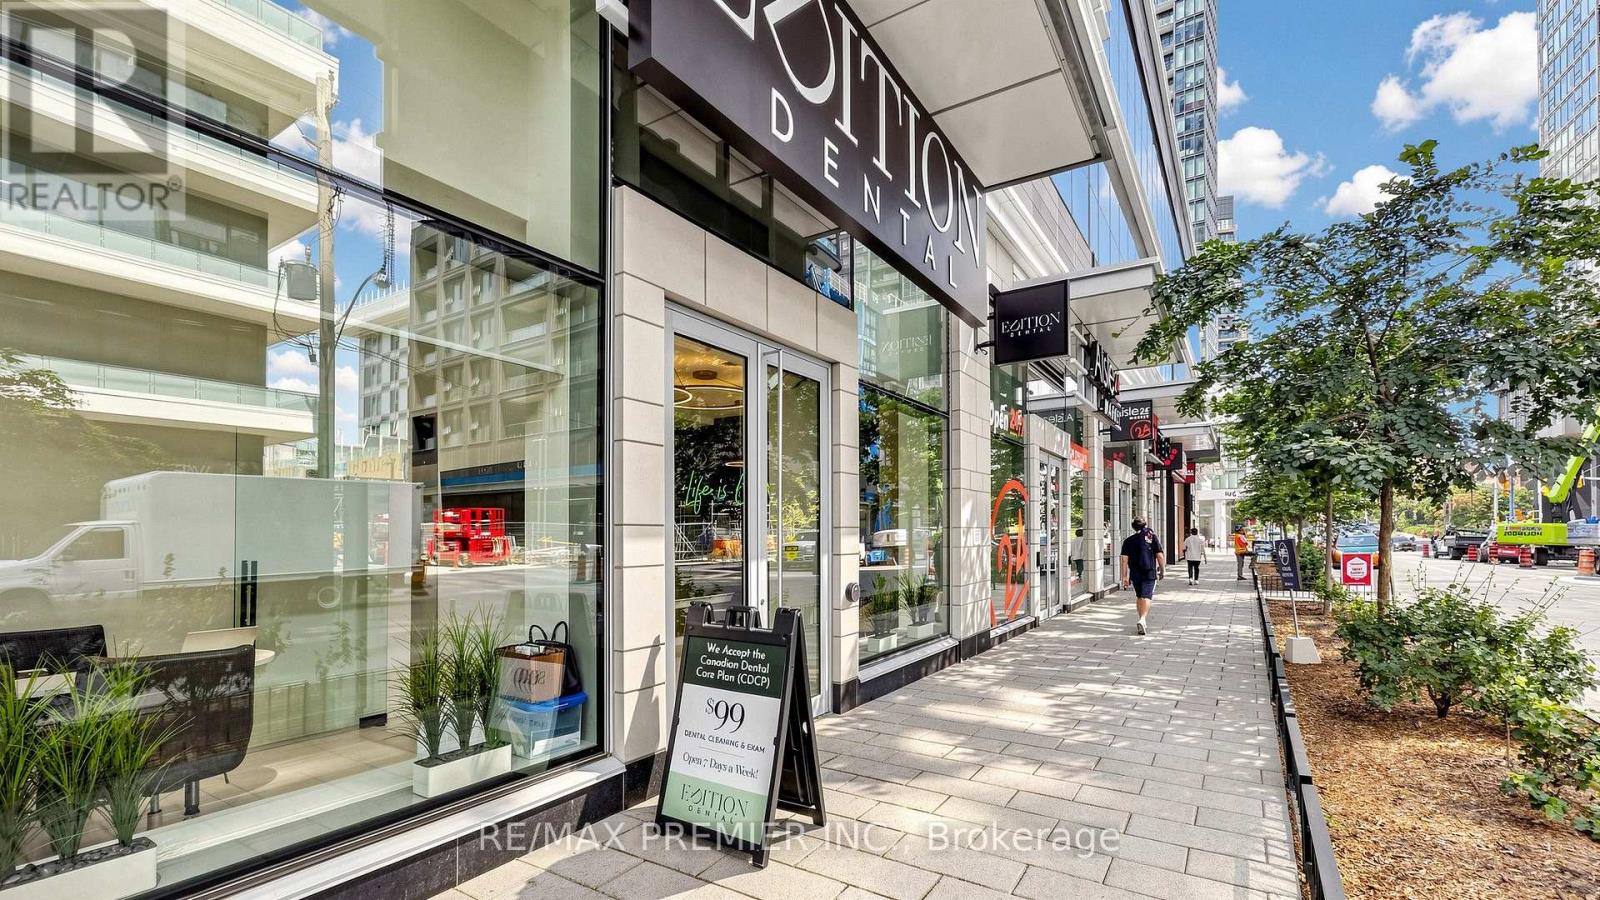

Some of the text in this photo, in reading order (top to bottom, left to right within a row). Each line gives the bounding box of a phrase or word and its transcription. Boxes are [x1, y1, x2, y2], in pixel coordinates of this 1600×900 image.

[771, 87, 957, 288] DENTAL
[1117, 406, 1150, 419] isle2
[707, 642, 766, 660] We Accept the
[700, 655, 770, 674] Canadian Dental
[696, 666, 770, 689] Care Plan (CDCP)
[705, 697, 745, 734] $99
[684, 729, 706, 740] DENTAL
[708, 734, 738, 748] CLEANING
[747, 743, 765, 754] EXAM
[682, 752, 759, 779] Open 7 Days a Week!
[688, 805, 737, 825] DENTAL
